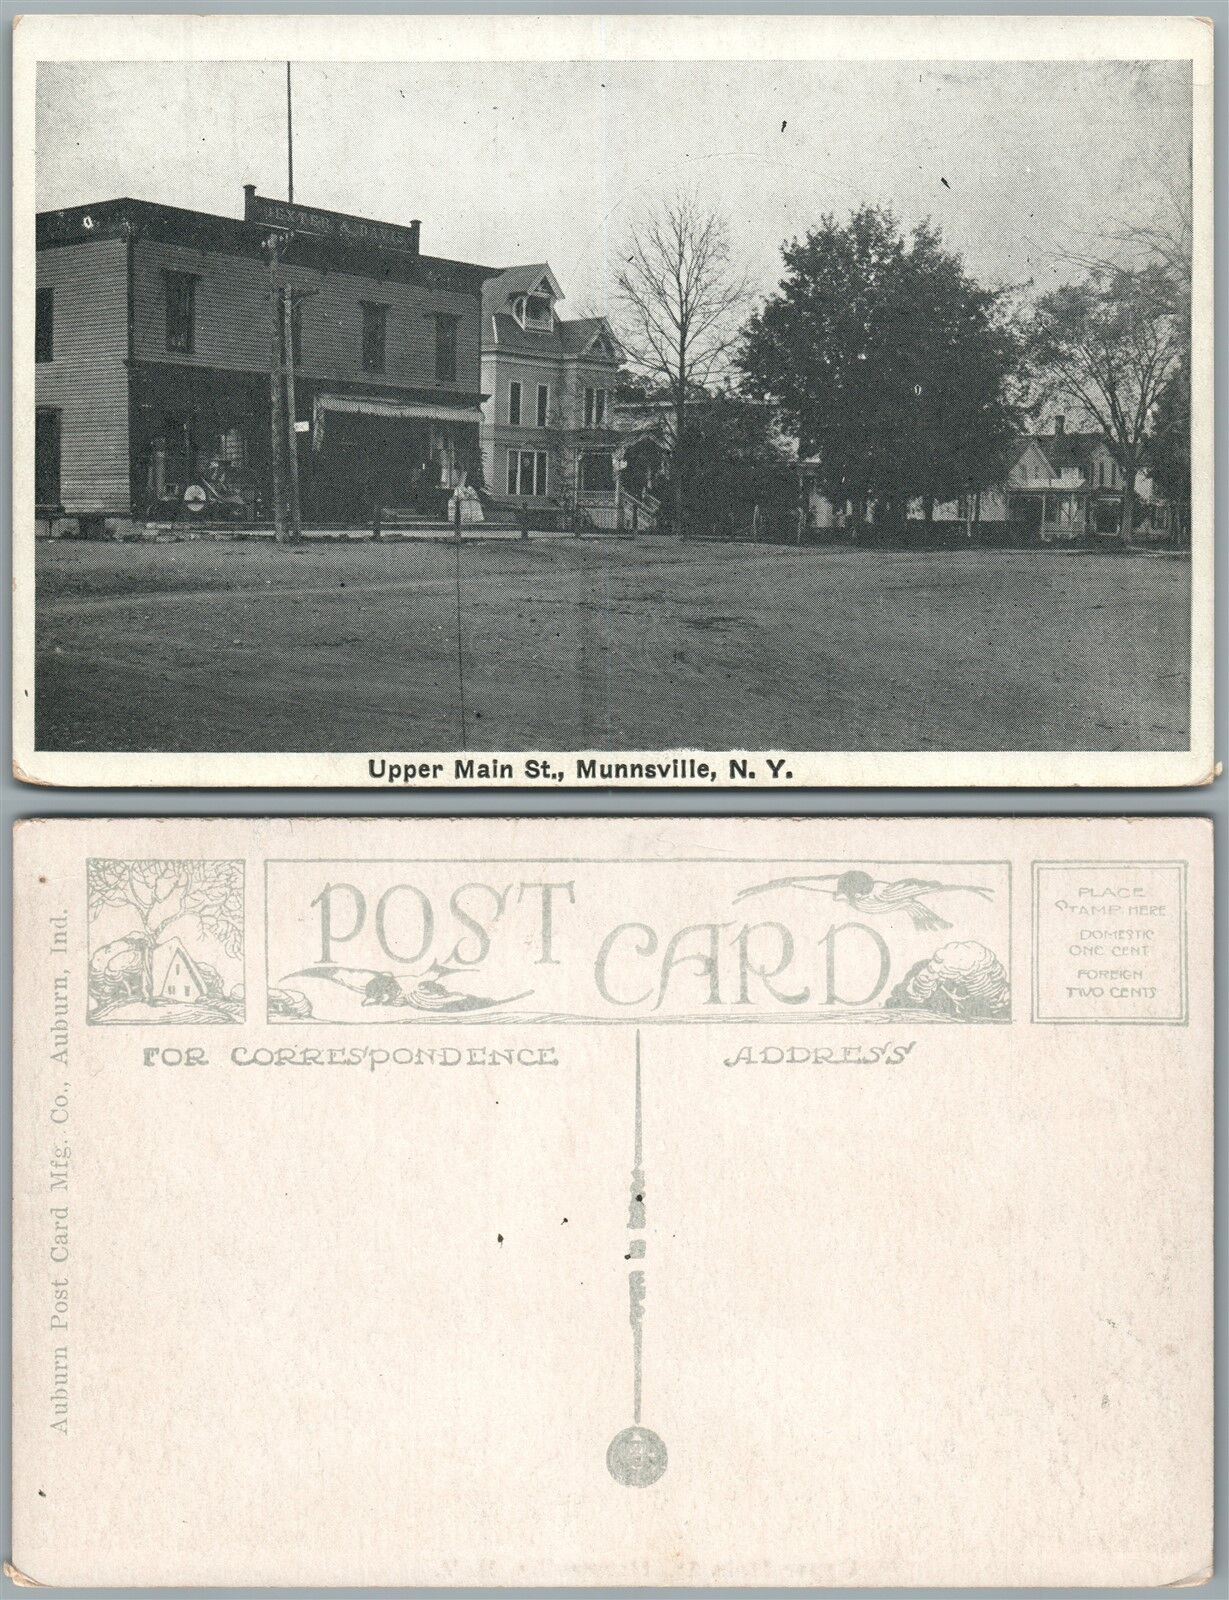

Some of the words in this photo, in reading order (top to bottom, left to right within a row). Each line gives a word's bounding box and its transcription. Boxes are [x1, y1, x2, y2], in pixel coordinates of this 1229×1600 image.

[368, 759, 443, 783] Upper
[455, 759, 513, 779] Main
[525, 759, 564, 783] St.,
[576, 758, 716, 783] Munnsville,
[729, 759, 756, 780] N.
[765, 758, 793, 779] Y.
[1078, 887, 1146, 898] PLACE
[1055, 899, 1122, 916] STAMP
[1128, 905, 1166, 917] HERE
[49, 909, 68, 953] Ind.
[311, 880, 576, 966] POST
[594, 920, 891, 1010] CARD
[1080, 929, 1154, 941] DOMESTIC
[1069, 944, 1104, 957] ONE
[1111, 945, 1150, 957] CENT
[1077, 969, 1143, 981] FOREIGN
[1065, 986, 1104, 998] TWO
[1110, 986, 1157, 999] CENTS
[49, 969, 71, 1066] Auburn,
[143, 1047, 210, 1068] FOR
[231, 1045, 560, 1073] CORRESPONDENCE
[723, 1041, 916, 1068] ADDRESS
[50, 1079, 72, 1126] Co.,
[50, 1140, 72, 1192] Mfg.
[50, 1206, 69, 1263] Card
[50, 1278, 69, 1330] Post
[50, 1346, 69, 1436] Auburn
